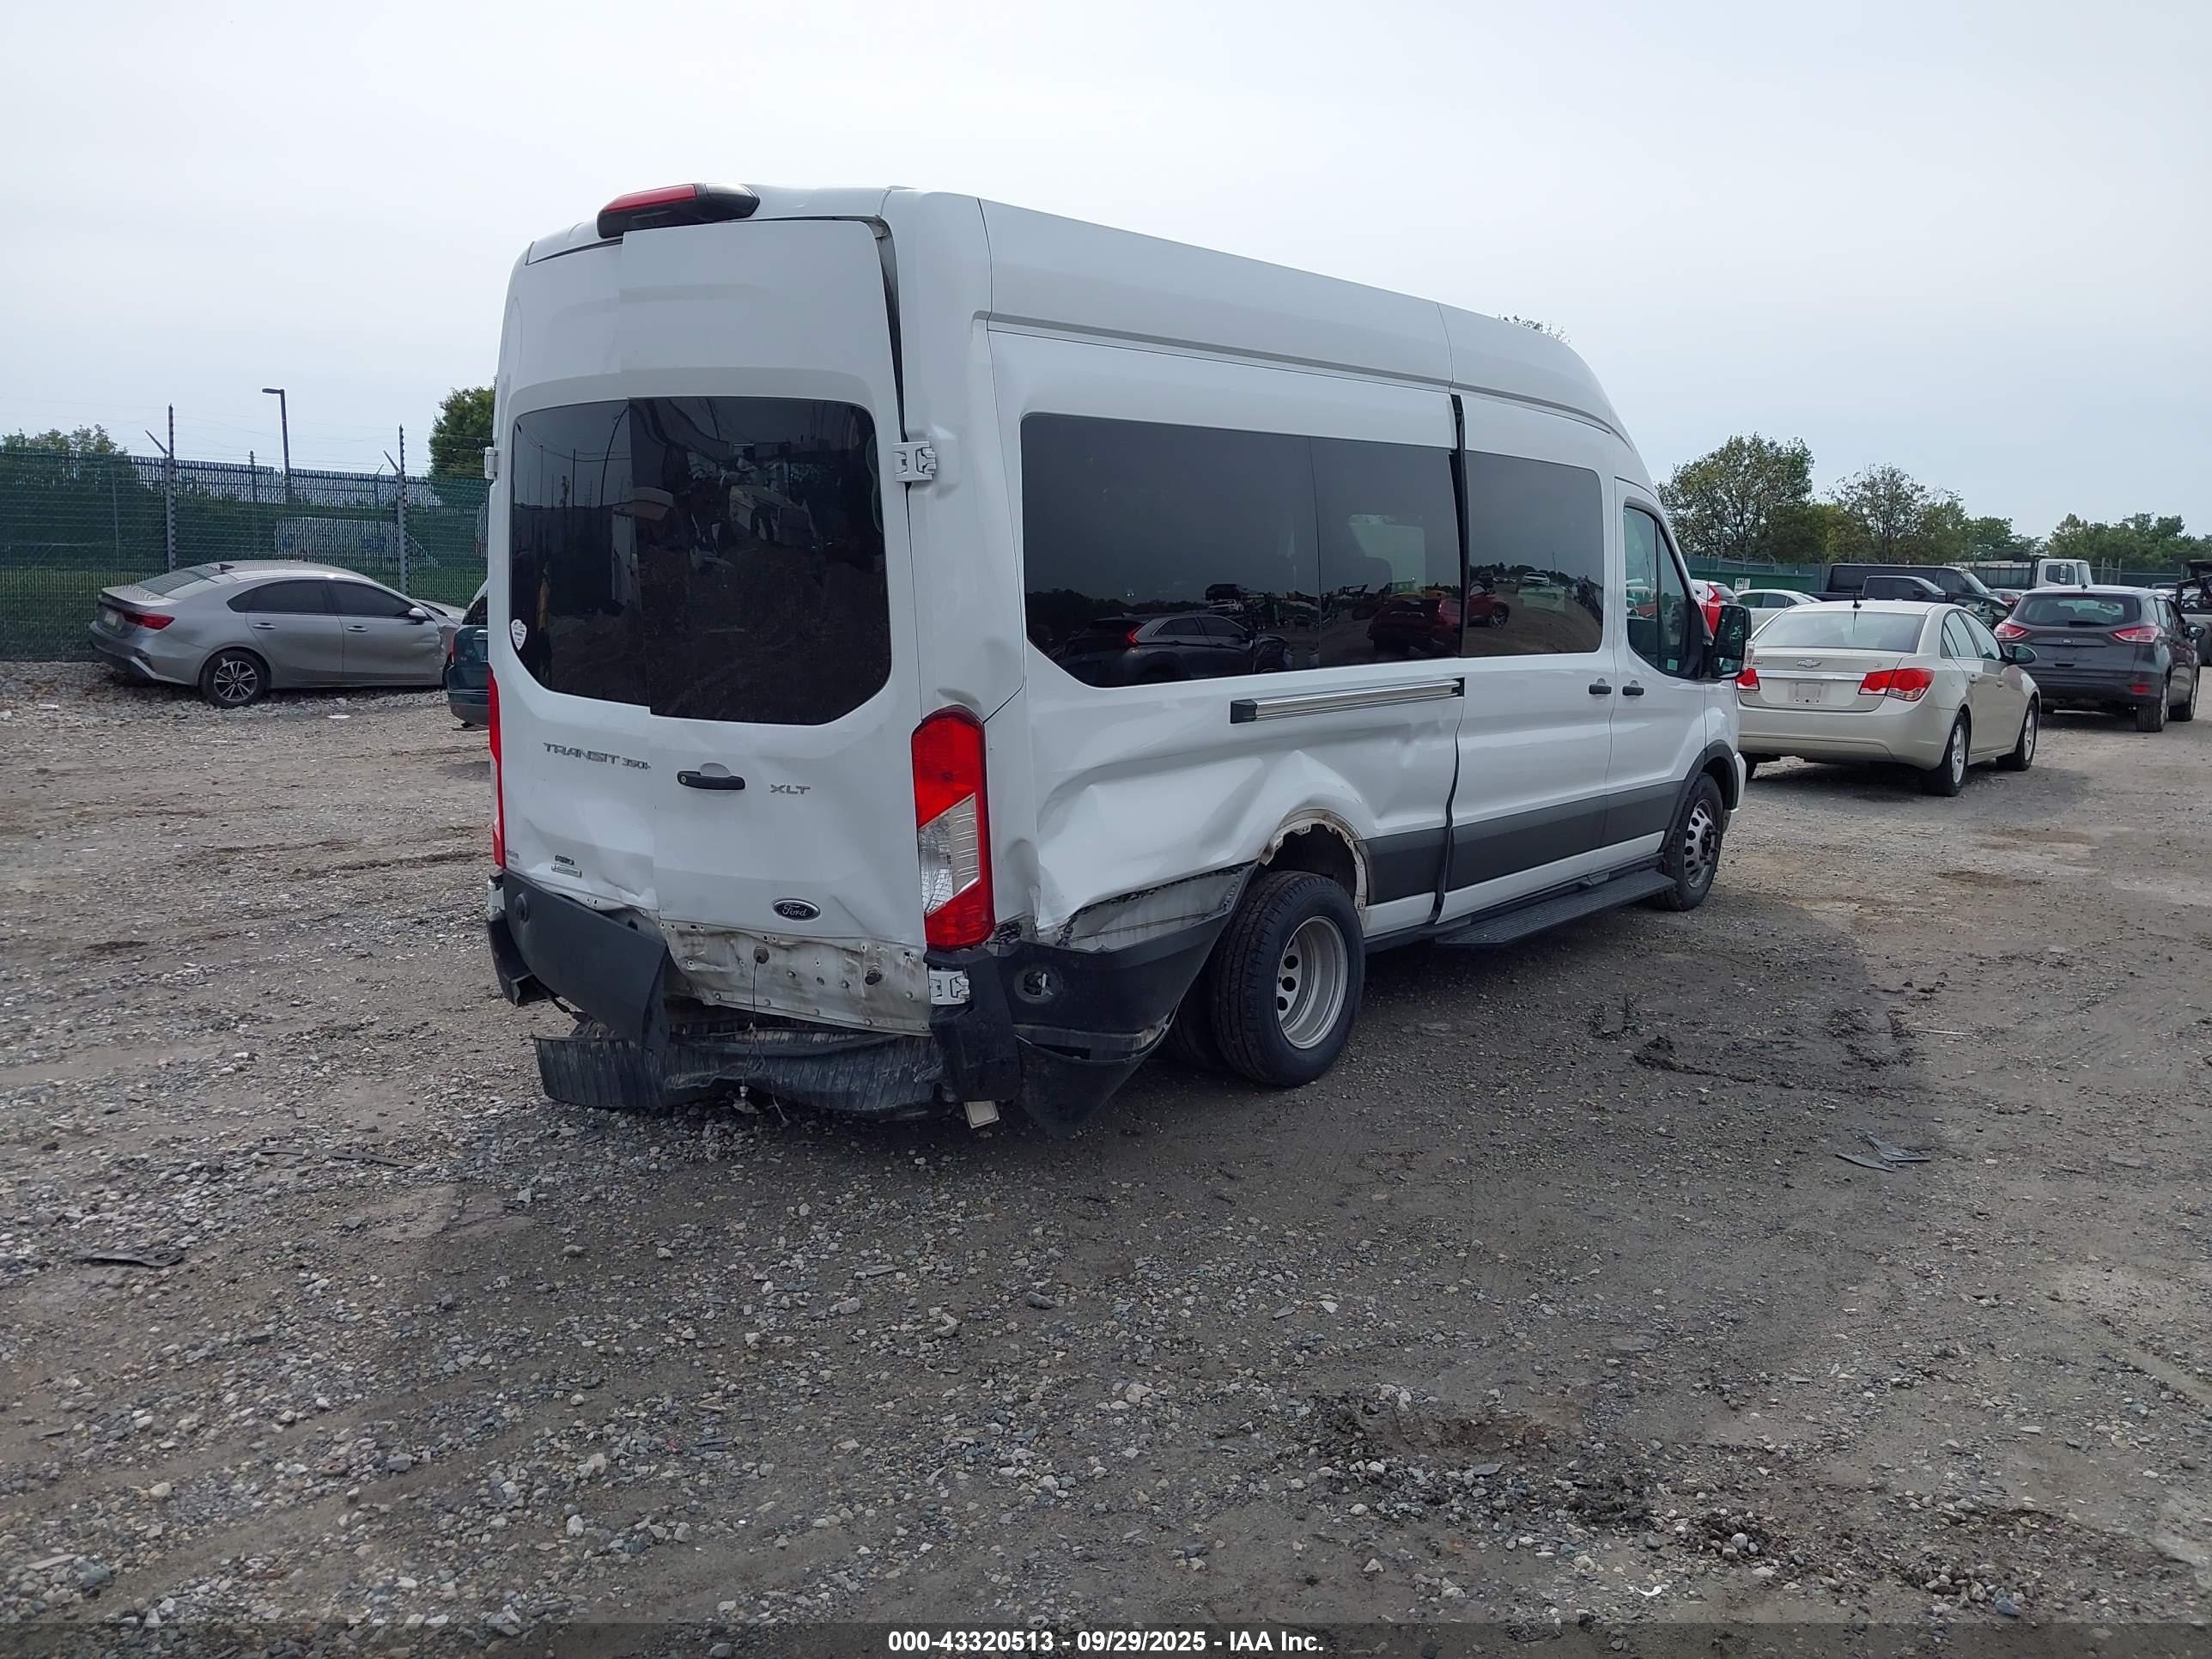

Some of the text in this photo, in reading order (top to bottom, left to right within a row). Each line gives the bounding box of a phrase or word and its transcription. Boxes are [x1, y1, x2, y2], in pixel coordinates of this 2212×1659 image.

[543, 742, 620, 764] TRANSIT
[769, 783, 811, 795] XLT
[781, 903, 808, 916] Ford
